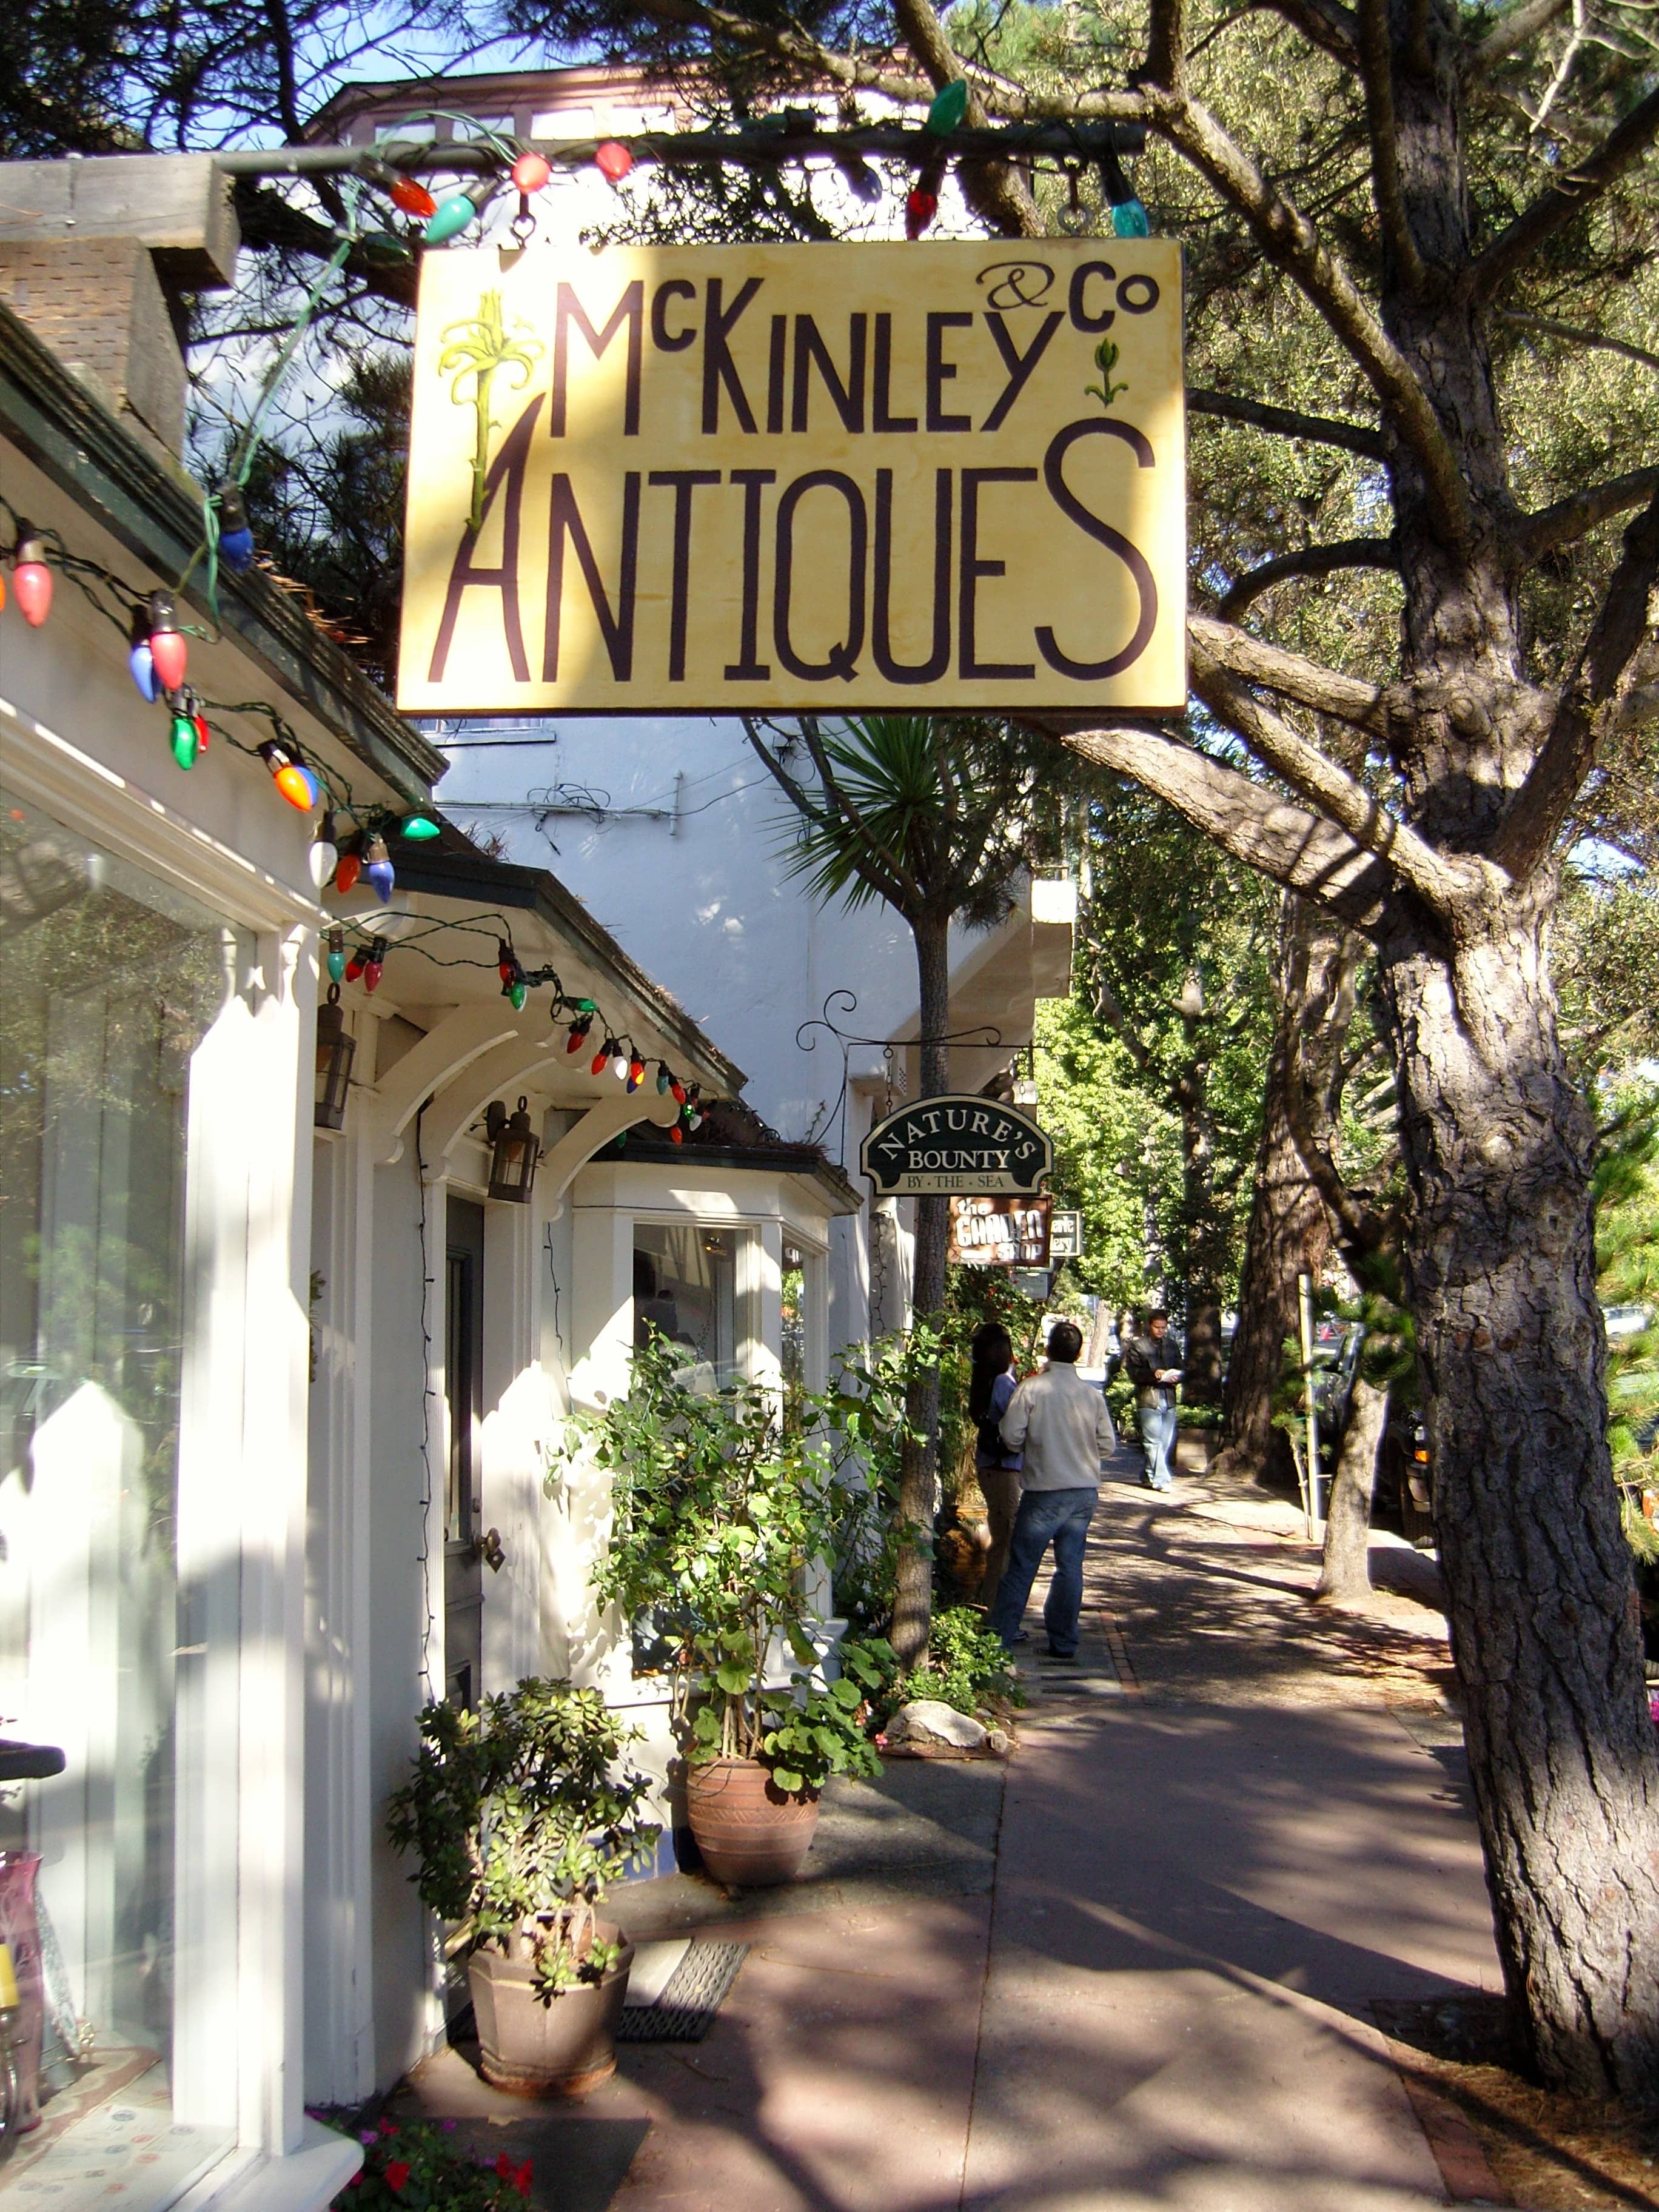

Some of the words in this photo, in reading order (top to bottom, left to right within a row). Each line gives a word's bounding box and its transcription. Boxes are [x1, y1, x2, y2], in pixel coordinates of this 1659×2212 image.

[976, 261, 1055, 310] &
[1068, 261, 1160, 333] Co
[427, 392, 1158, 685] ANTIQUES
[878, 1109, 1036, 1161] NATURE'S
[908, 1150, 1010, 1169] BOUNTY
[907, 1176, 924, 1188] BY
[934, 1176, 964, 1188] THE
[977, 1176, 1004, 1187] SEA
[957, 1198, 993, 1215] the
[997, 1242, 1042, 1260] SHOP
[1050, 1234, 1073, 1253] lery
